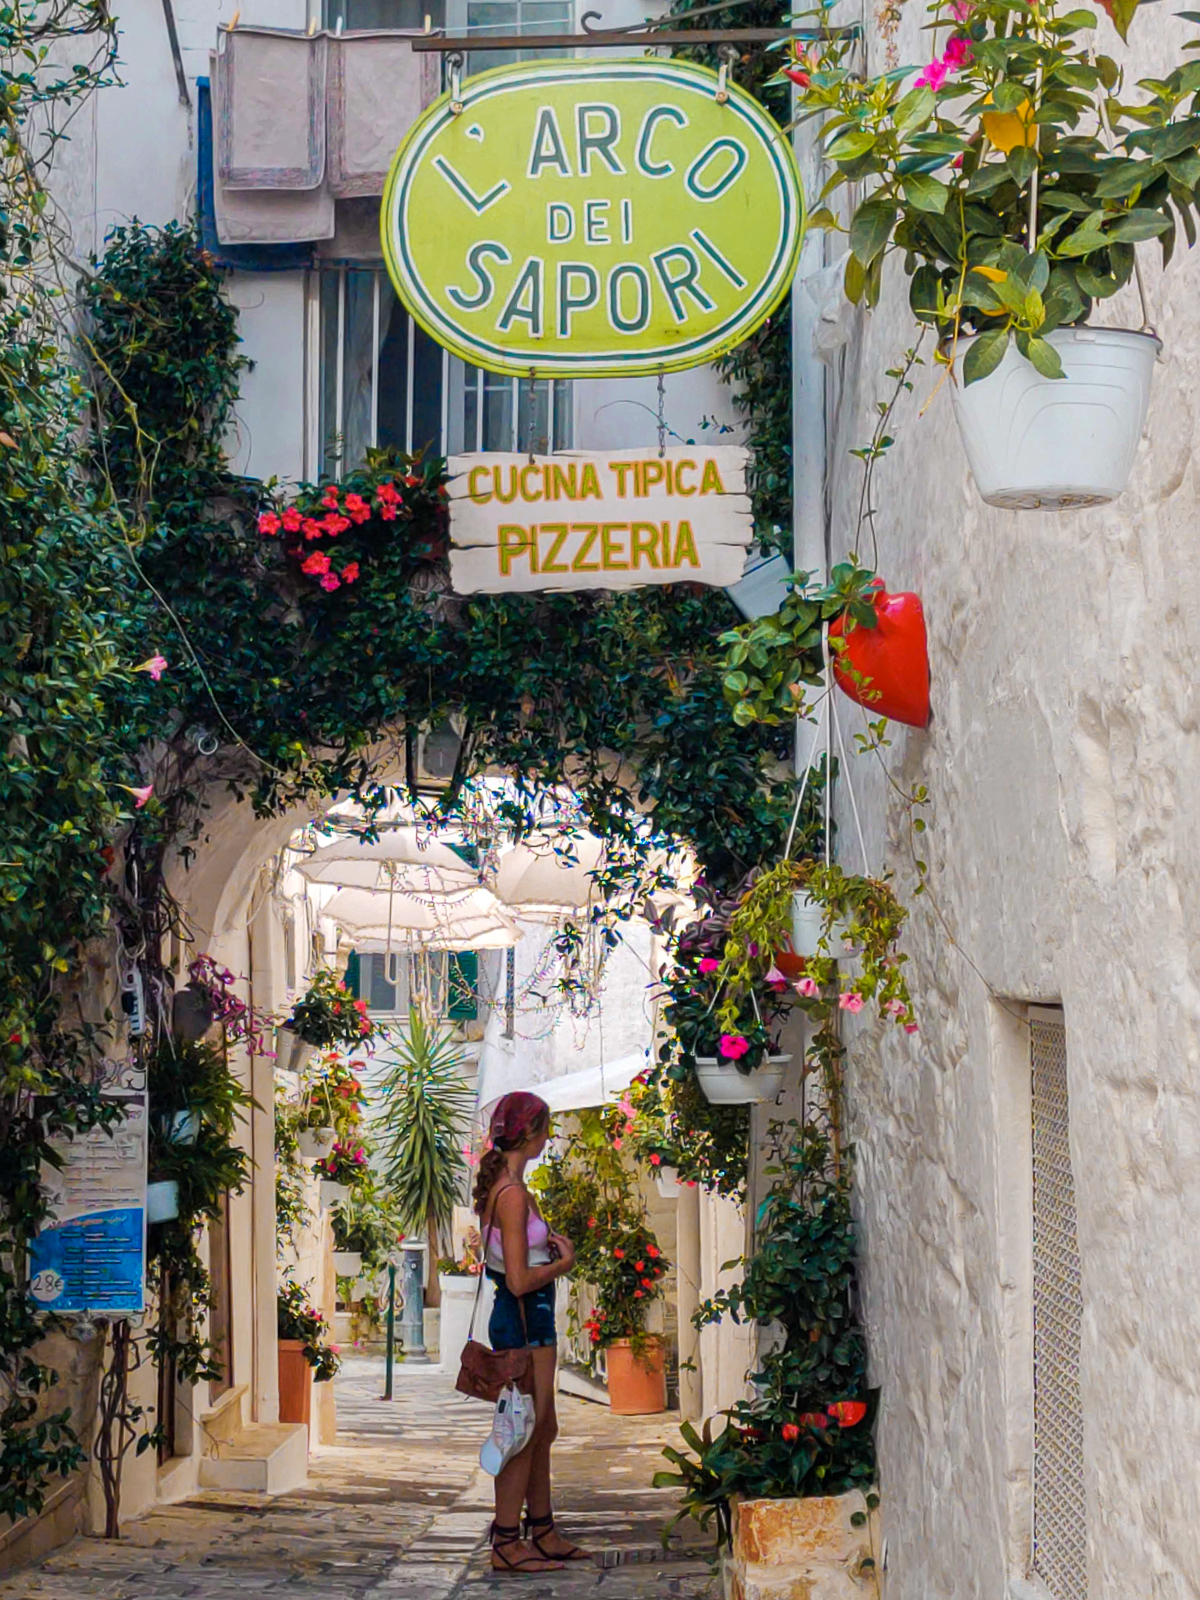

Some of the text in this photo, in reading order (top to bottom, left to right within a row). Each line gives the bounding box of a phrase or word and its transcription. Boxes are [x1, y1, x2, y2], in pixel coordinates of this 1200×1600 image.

[547, 200, 633, 244] DEI
[446, 229, 748, 338] SAPORI
[467, 459, 725, 505] CUCINA TIPICA
[498, 521, 702, 577] PIZZERIA
